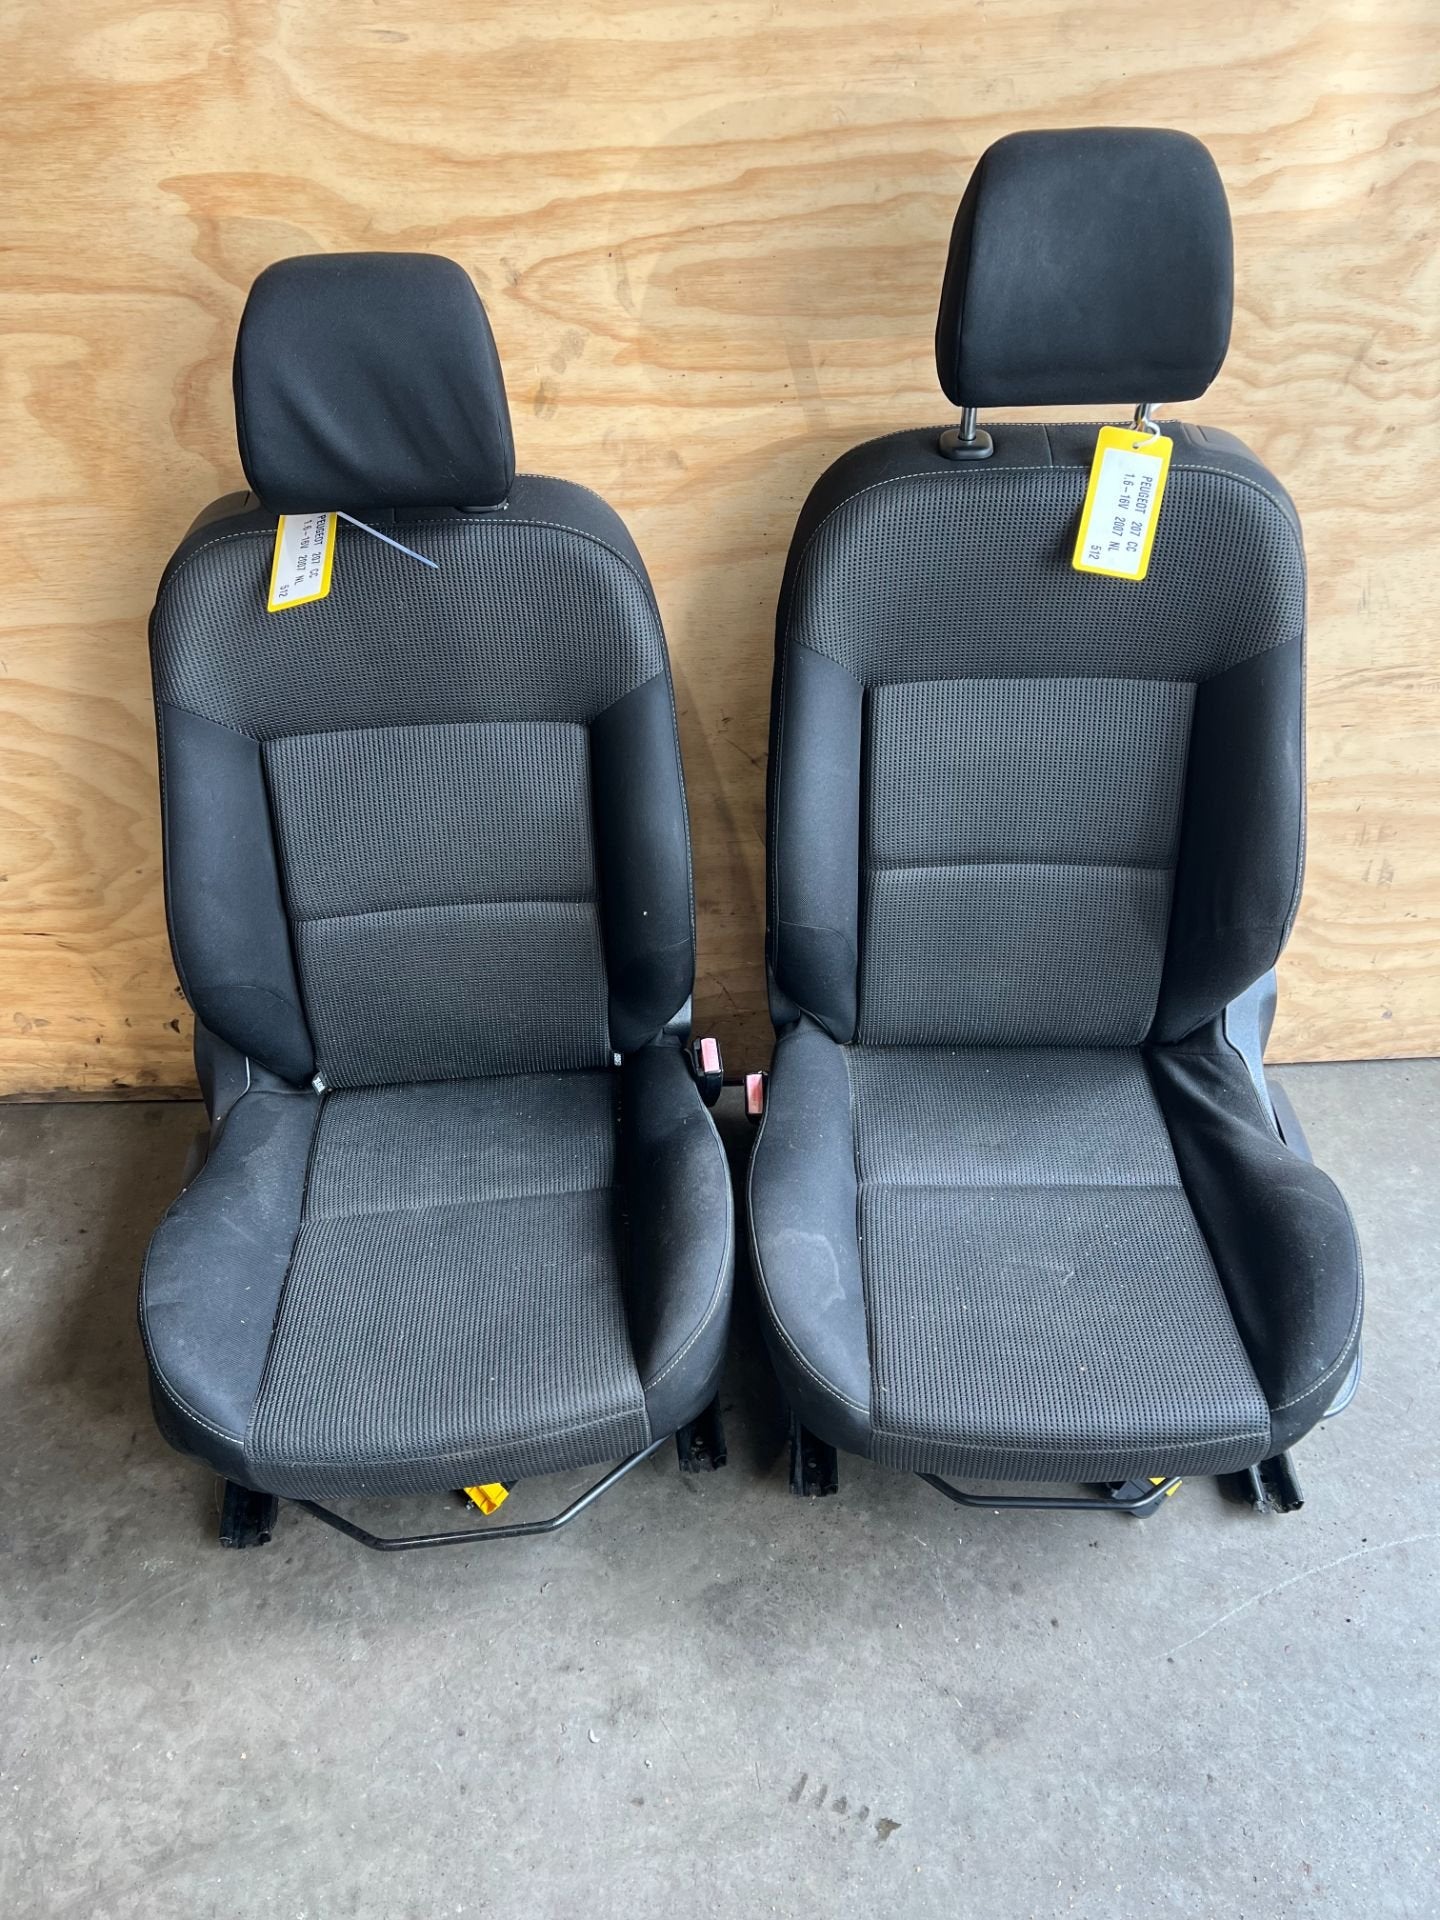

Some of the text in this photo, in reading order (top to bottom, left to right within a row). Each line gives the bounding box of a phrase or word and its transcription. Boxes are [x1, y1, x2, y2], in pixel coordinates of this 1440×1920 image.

[314, 514, 326, 546] PEUGEOT
[1108, 473, 1136, 552] 1.6-16V 2007 NL
[1126, 475, 1153, 553] PEUGEOT 207 CC
[1088, 544, 1102, 560] 512
